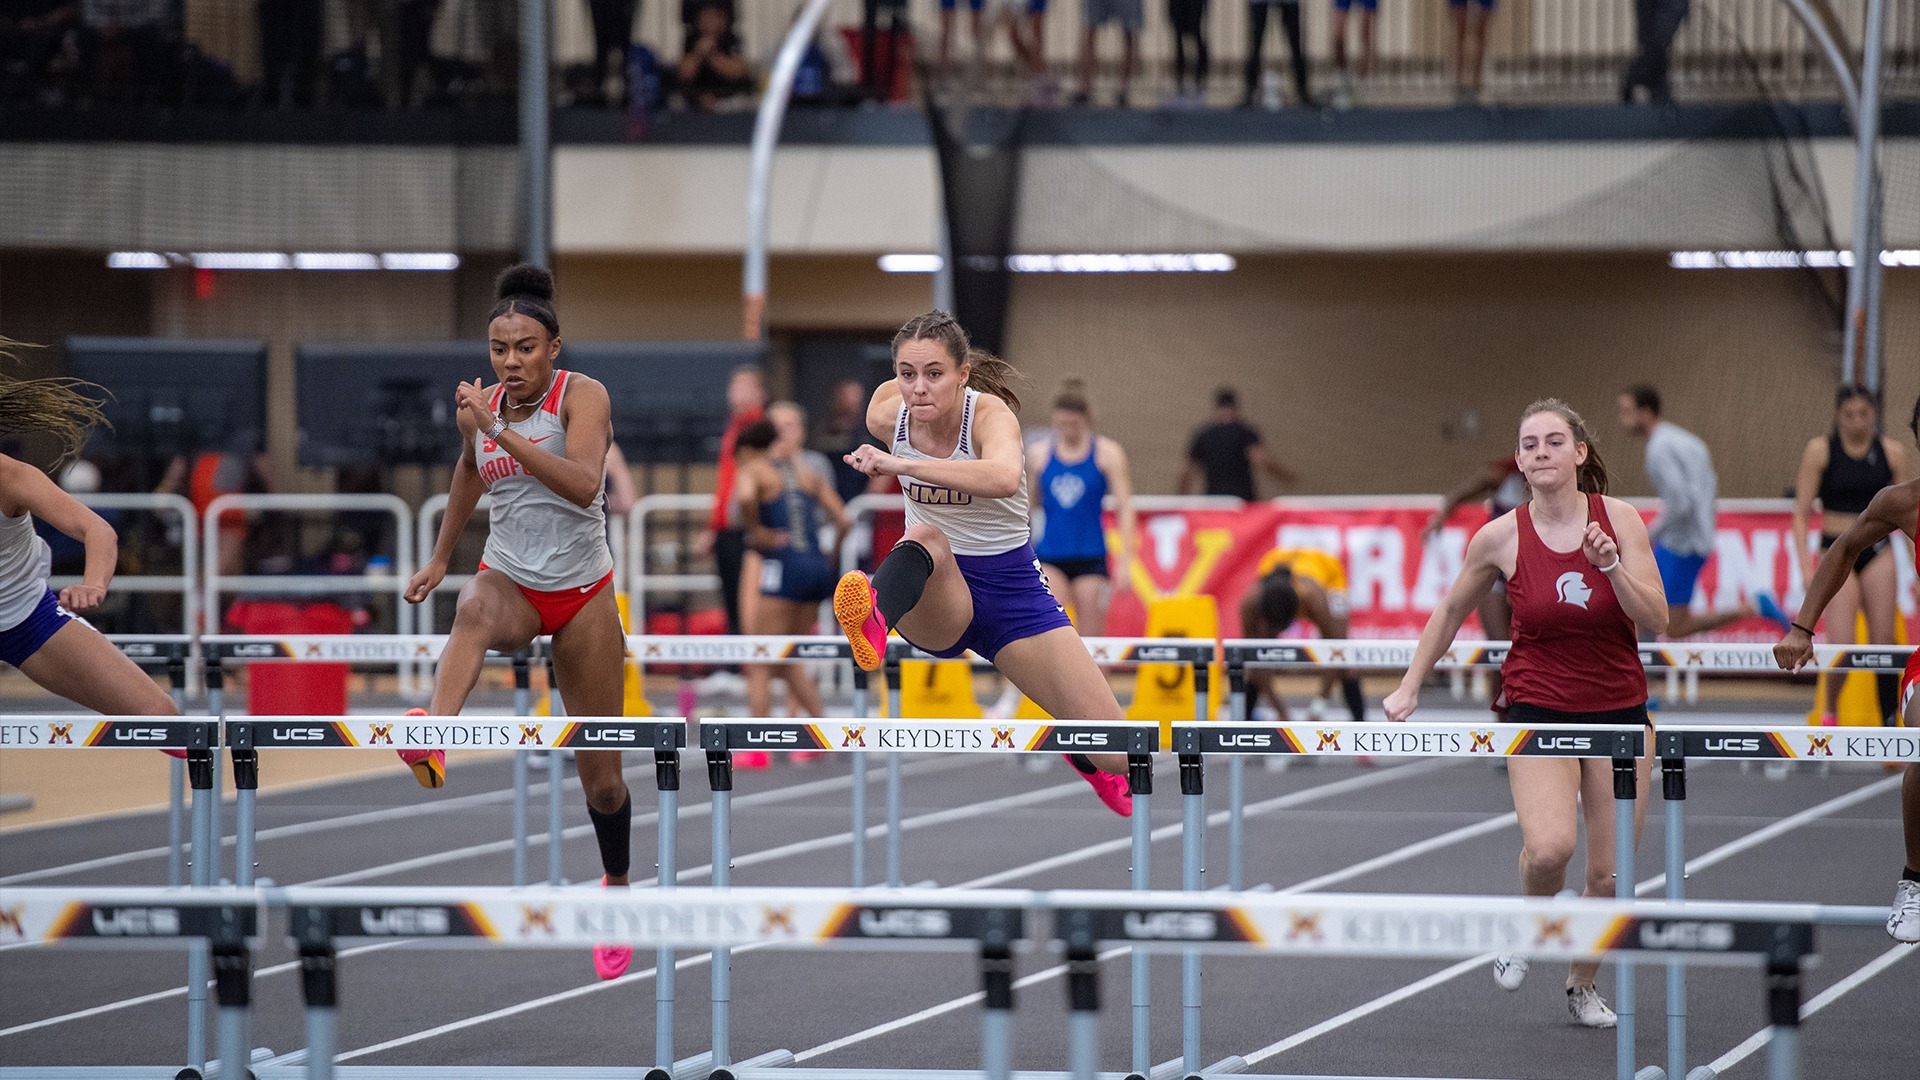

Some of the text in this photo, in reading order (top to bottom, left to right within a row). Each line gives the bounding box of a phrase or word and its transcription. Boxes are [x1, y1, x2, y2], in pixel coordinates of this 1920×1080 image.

[480, 455, 532, 487] RADF
[903, 482, 971, 505] JMU
[1276, 523, 1475, 612] TRA
[1256, 648, 1411, 662] UCS KEYDE
[1713, 650, 1893, 667] KEYDE UCS
[0, 725, 39, 745] ETS
[115, 728, 168, 741] UCS
[272, 728, 326, 741] UCS
[405, 726, 510, 746] KEYDETS
[584, 729, 637, 742] UCS
[746, 730, 799, 743] UCS
[877, 728, 983, 748] KEYDETS
[1056, 733, 1109, 746] UCS
[1218, 734, 1272, 747] UCS
[1353, 732, 1461, 753] KEYDETS
[1537, 736, 1592, 750] UCS
[1704, 738, 1761, 751] UCS
[1846, 737, 1920, 758] KEYD
[93, 907, 181, 935] UCS
[360, 908, 450, 935] UCS
[858, 908, 952, 937] UCS
